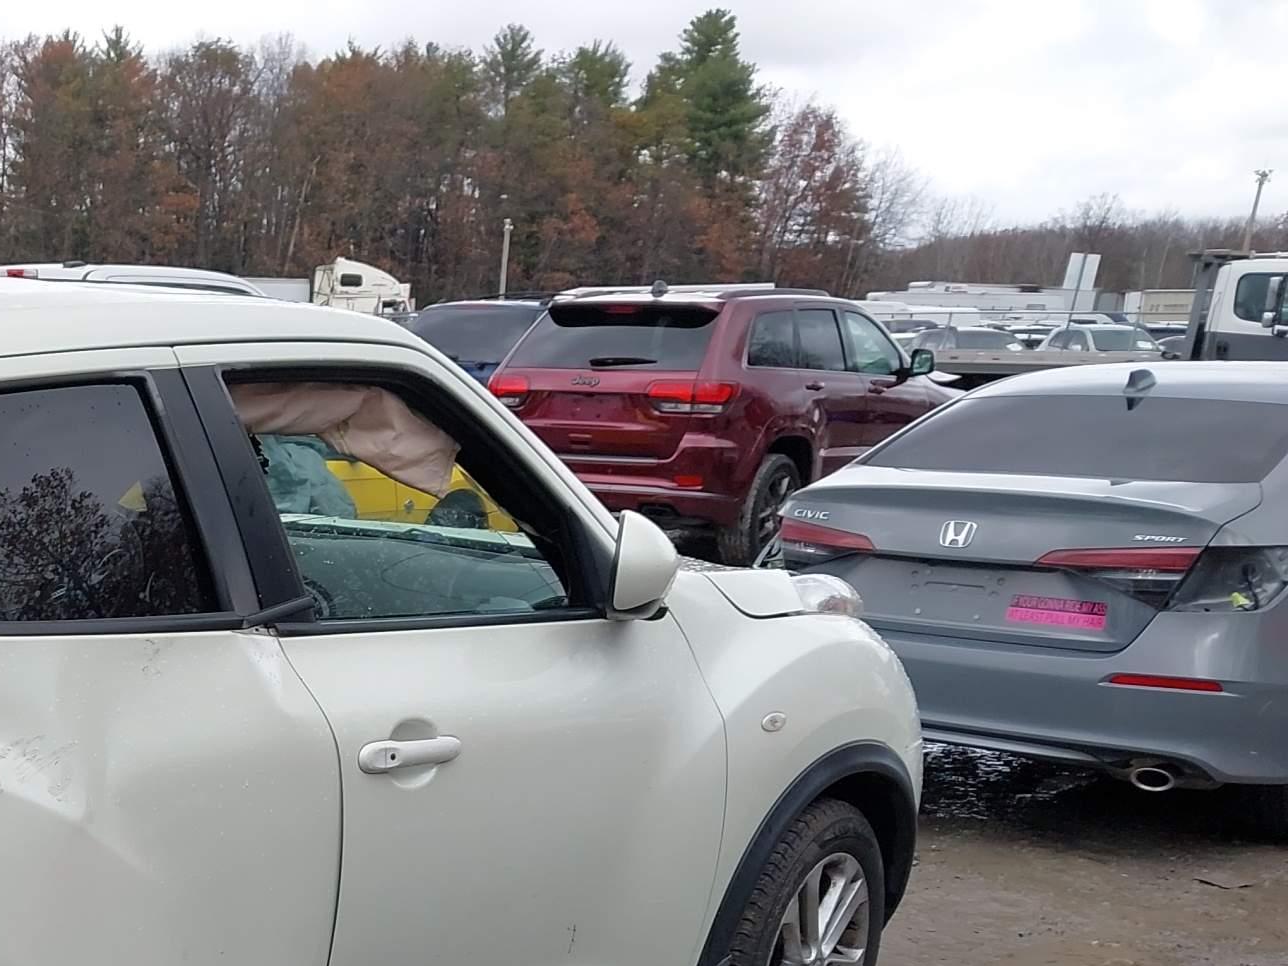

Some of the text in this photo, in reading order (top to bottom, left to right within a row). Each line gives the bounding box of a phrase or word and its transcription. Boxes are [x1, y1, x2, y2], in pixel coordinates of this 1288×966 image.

[571, 376, 600, 388] Jeep
[794, 508, 830, 520] CIVIC
[1133, 534, 1189, 543] SPORT
